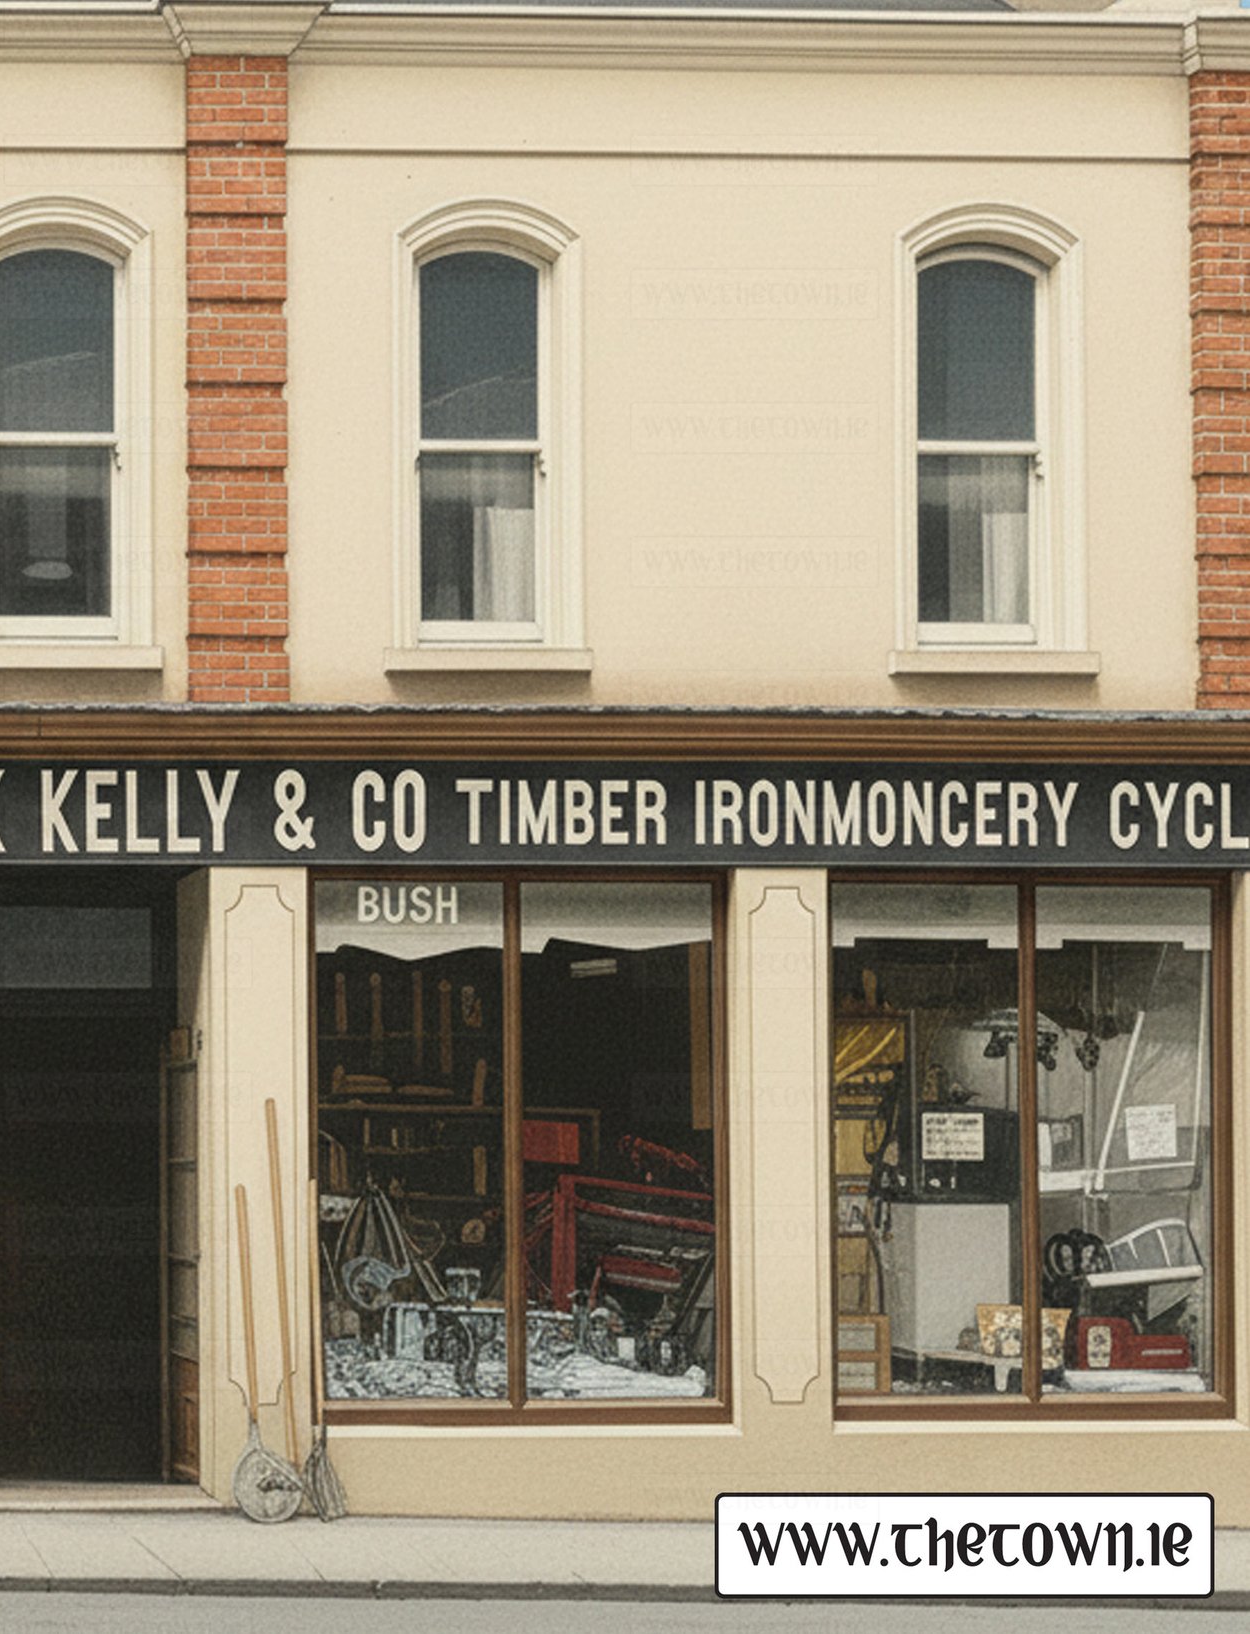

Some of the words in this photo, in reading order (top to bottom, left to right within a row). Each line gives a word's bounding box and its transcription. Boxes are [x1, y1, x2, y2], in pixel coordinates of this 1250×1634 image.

[42, 770, 239, 852] KELLY
[275, 770, 316, 851] &
[353, 770, 425, 852] CO
[456, 780, 666, 844] TIMBER
[1111, 782, 1249, 849] CYCL
[358, 886, 458, 924] BUSH
